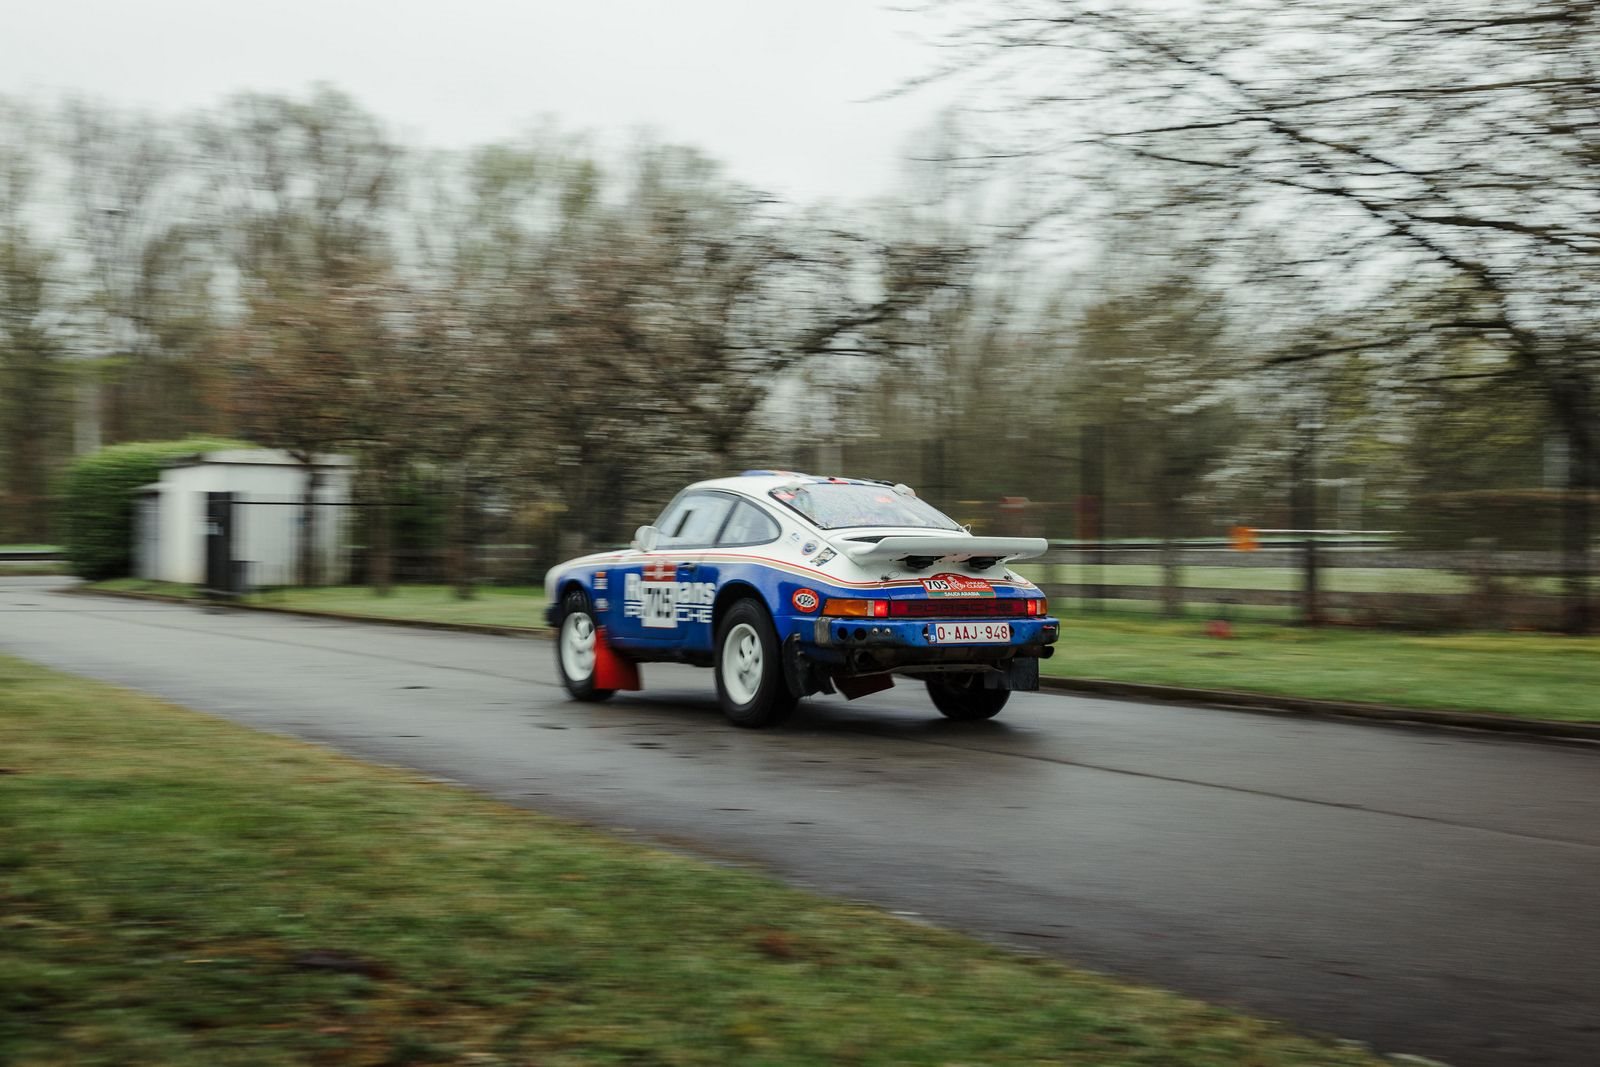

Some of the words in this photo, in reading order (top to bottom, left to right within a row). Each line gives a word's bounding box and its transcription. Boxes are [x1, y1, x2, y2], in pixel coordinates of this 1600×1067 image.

[925, 580, 949, 590] 705
[643, 587, 670, 618] 705
[908, 602, 1012, 614] PORSCHE
